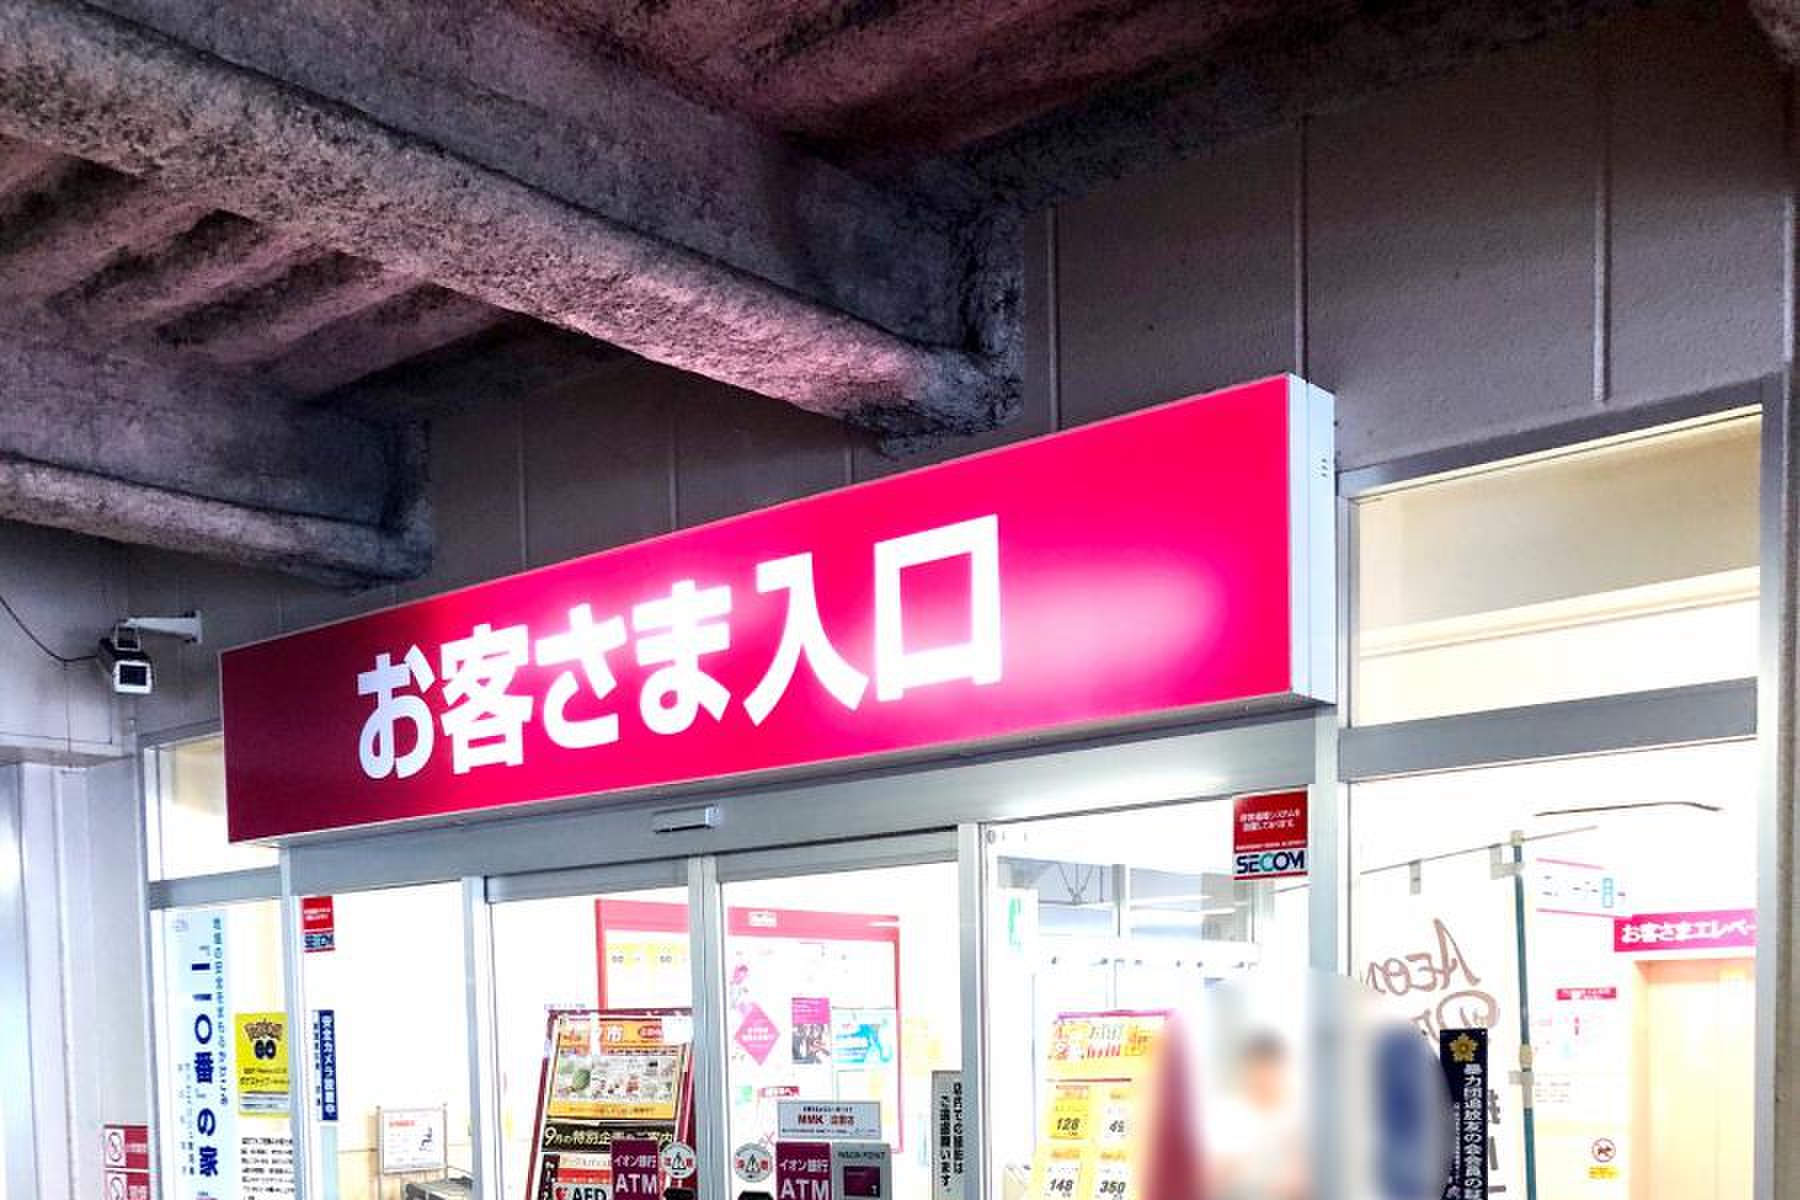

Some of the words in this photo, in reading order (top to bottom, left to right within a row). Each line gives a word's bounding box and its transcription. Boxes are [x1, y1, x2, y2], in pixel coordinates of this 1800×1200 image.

[357, 513, 1003, 780] お客さま入口
[1236, 850, 1304, 875] SECOM
[614, 1173, 658, 1195] ATM
[780, 1178, 830, 1200] ATM
